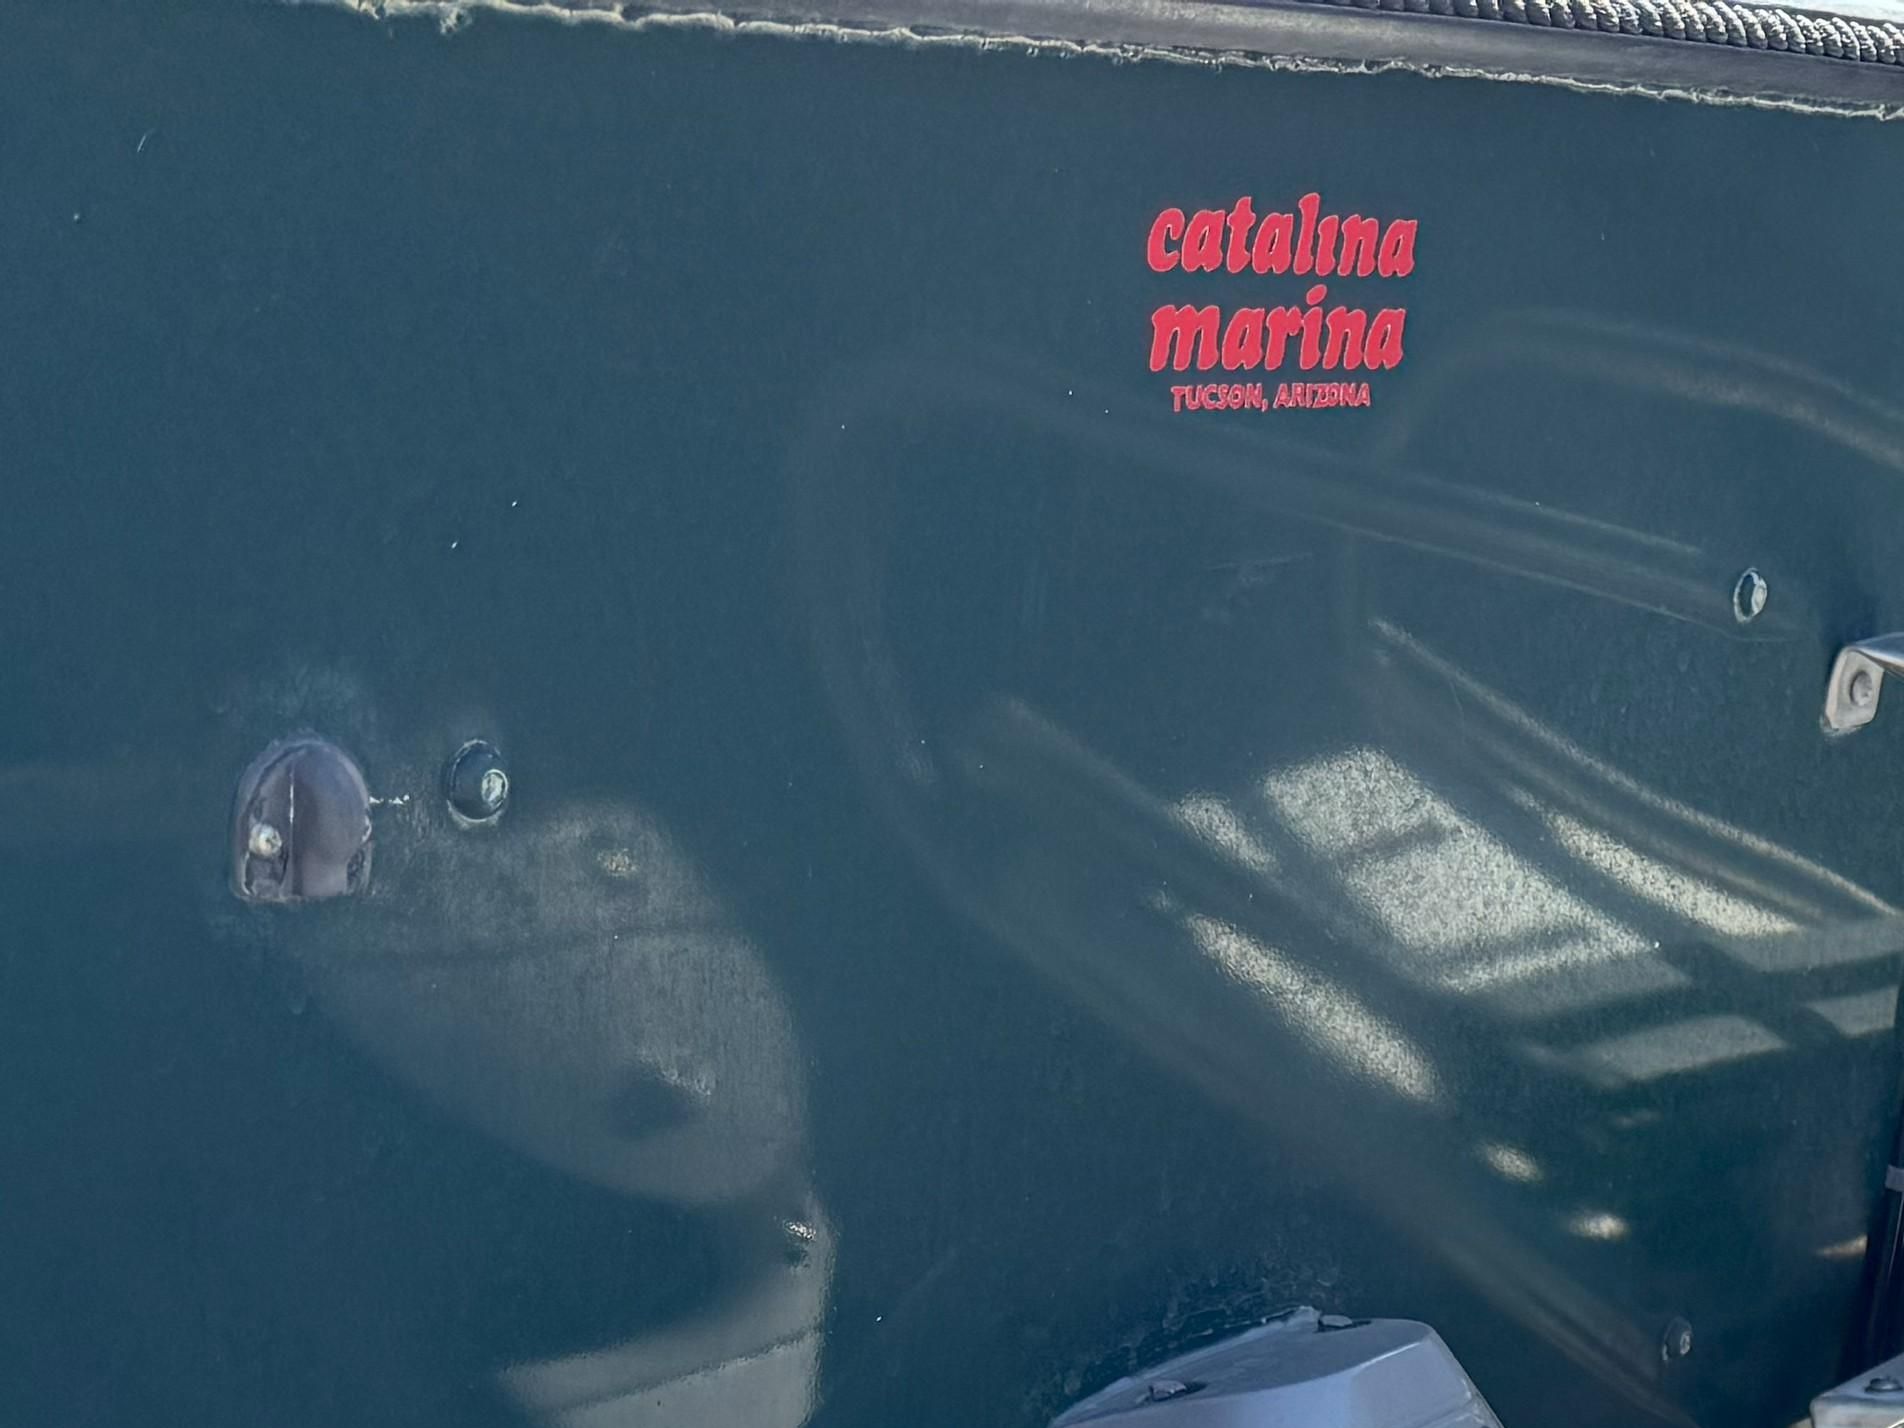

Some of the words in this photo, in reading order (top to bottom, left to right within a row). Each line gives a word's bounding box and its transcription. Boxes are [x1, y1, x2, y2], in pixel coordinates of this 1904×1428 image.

[1147, 192, 1418, 277] catalina
[1149, 284, 1407, 371] marina
[1171, 384, 1269, 412] TUCSON,
[1272, 383, 1372, 409] ARIZONA
